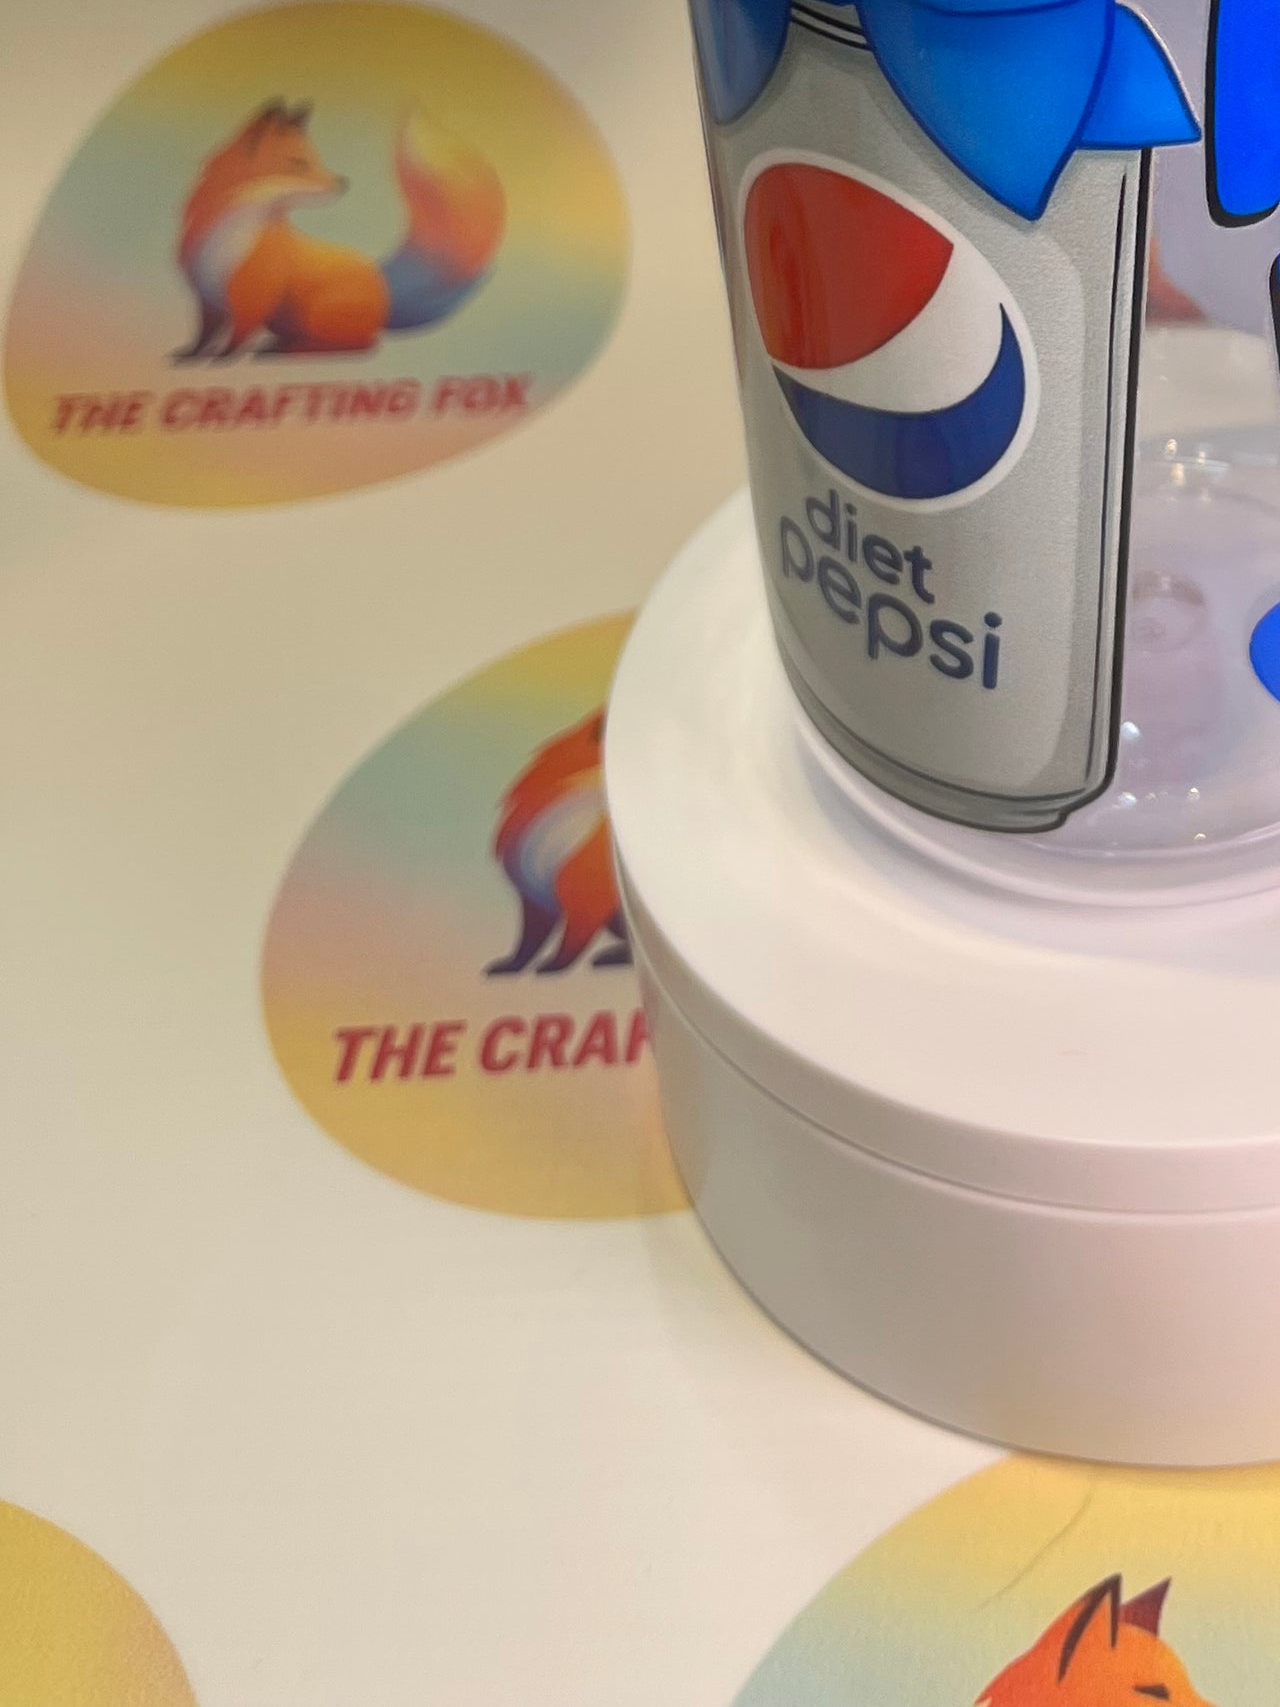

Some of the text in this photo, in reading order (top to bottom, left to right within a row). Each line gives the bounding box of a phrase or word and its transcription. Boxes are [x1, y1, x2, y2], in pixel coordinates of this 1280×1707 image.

[51, 372, 534, 437] THE CRAFTING FOX
[805, 488, 936, 605] diet
[779, 515, 1003, 690] pepsi
[333, 1018, 468, 1084] THE
